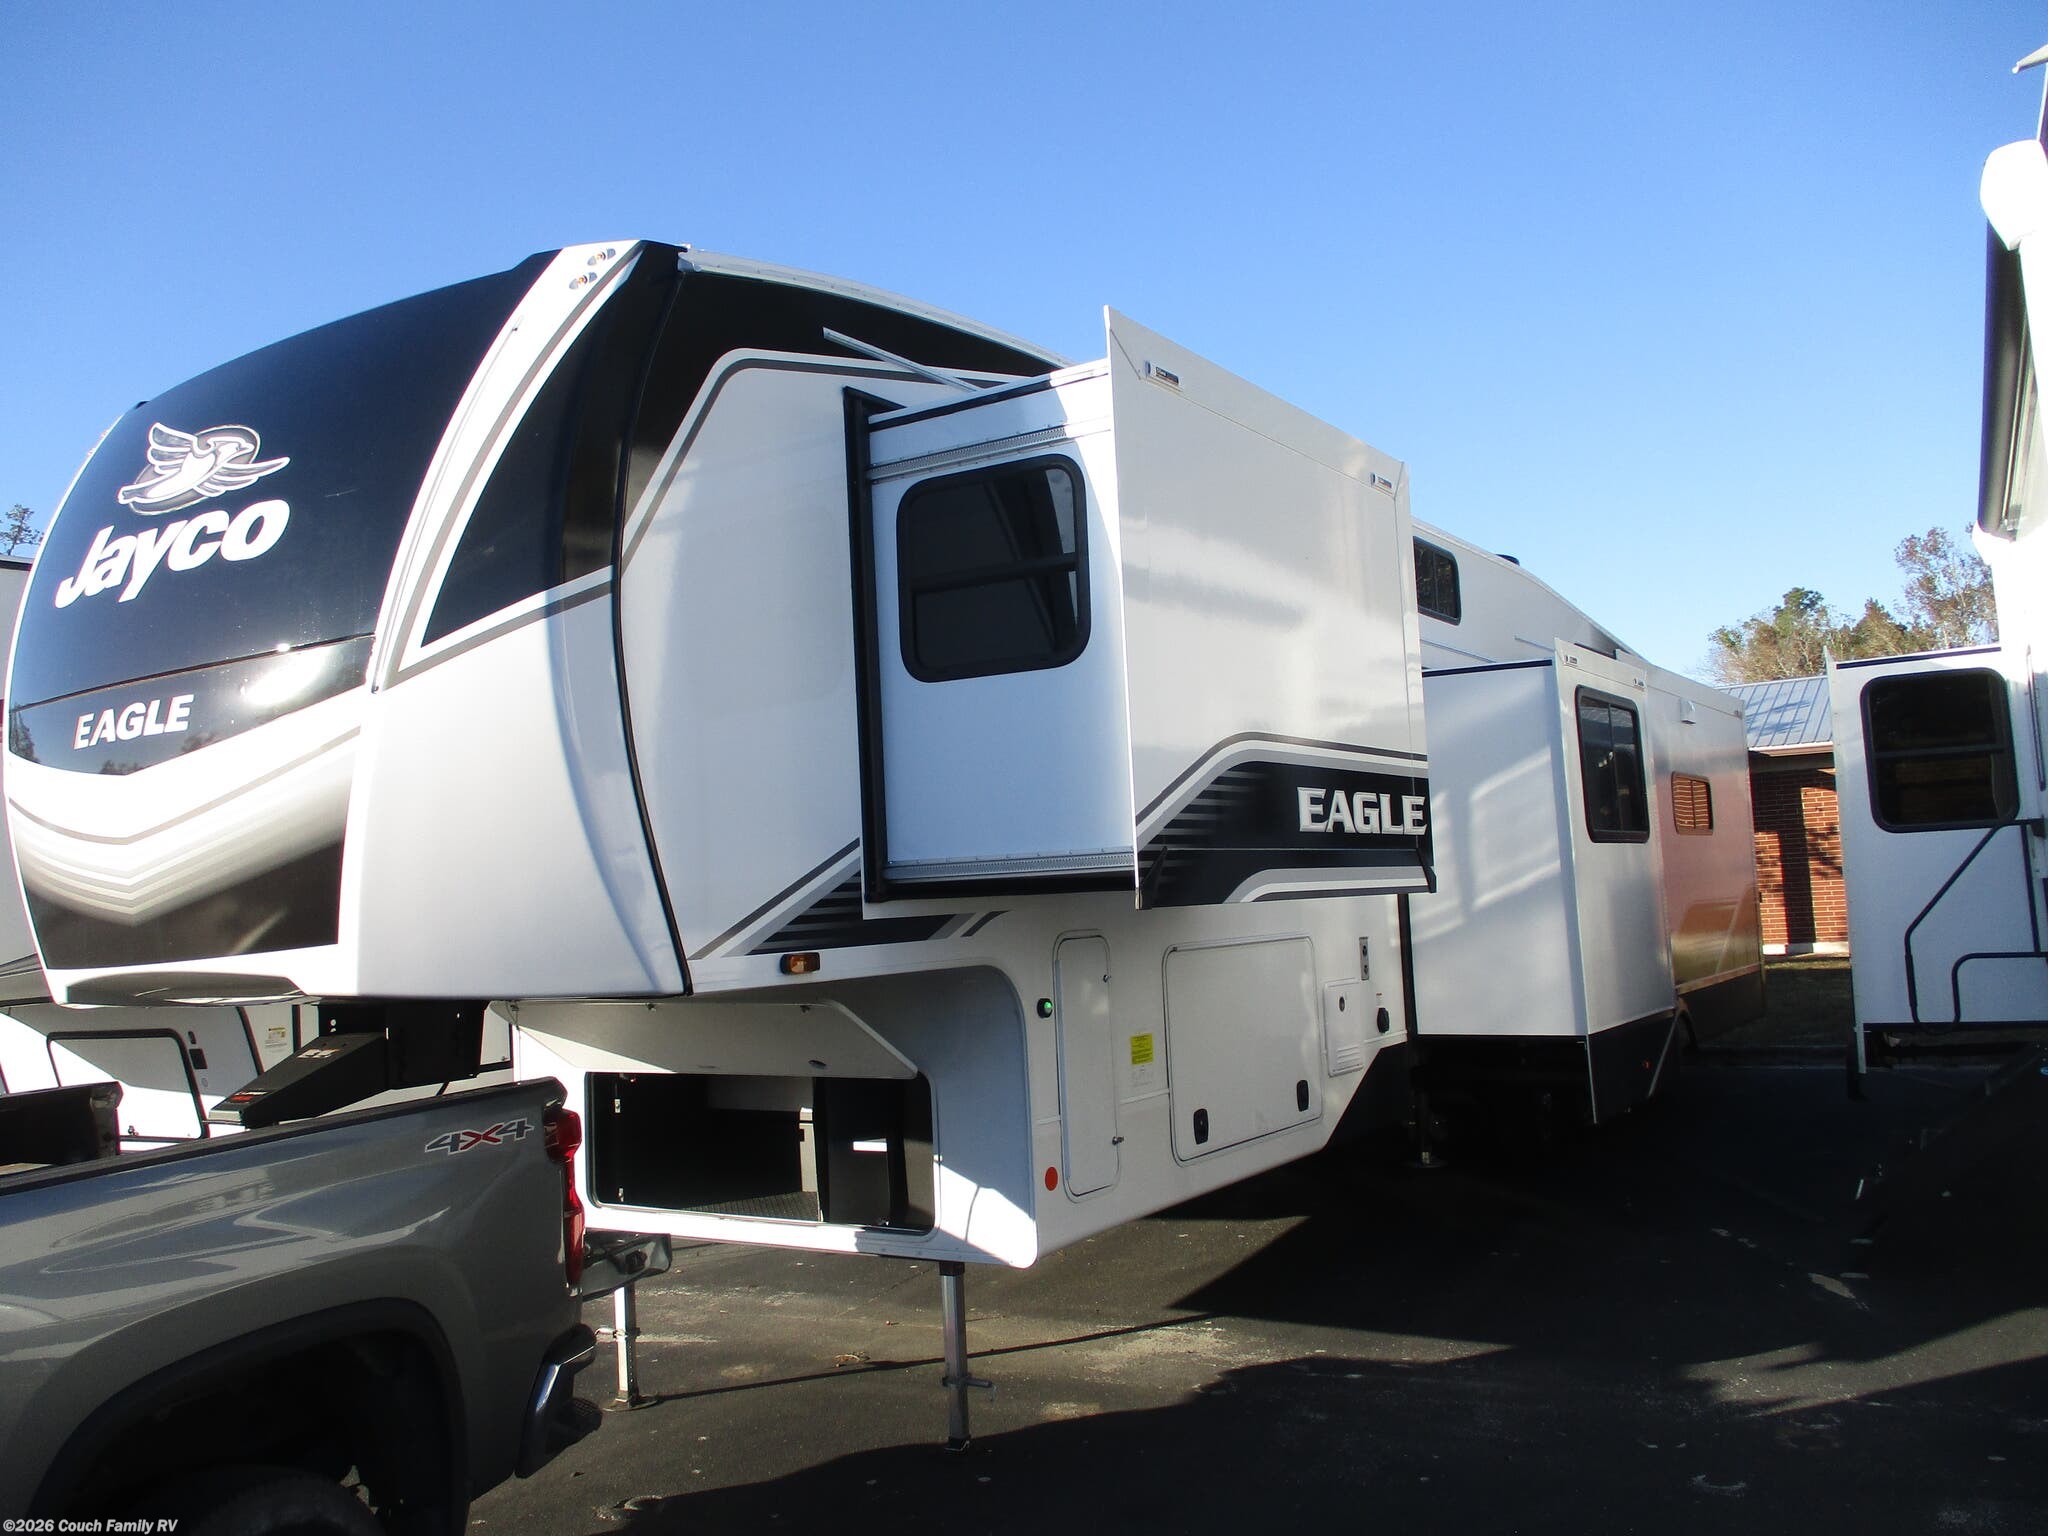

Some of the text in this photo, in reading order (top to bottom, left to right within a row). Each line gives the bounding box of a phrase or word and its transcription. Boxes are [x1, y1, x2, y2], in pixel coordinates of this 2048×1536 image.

[54, 498, 291, 609] Jayco
[73, 694, 195, 750] EAGLE
[1296, 786, 1428, 836] EAGLE
